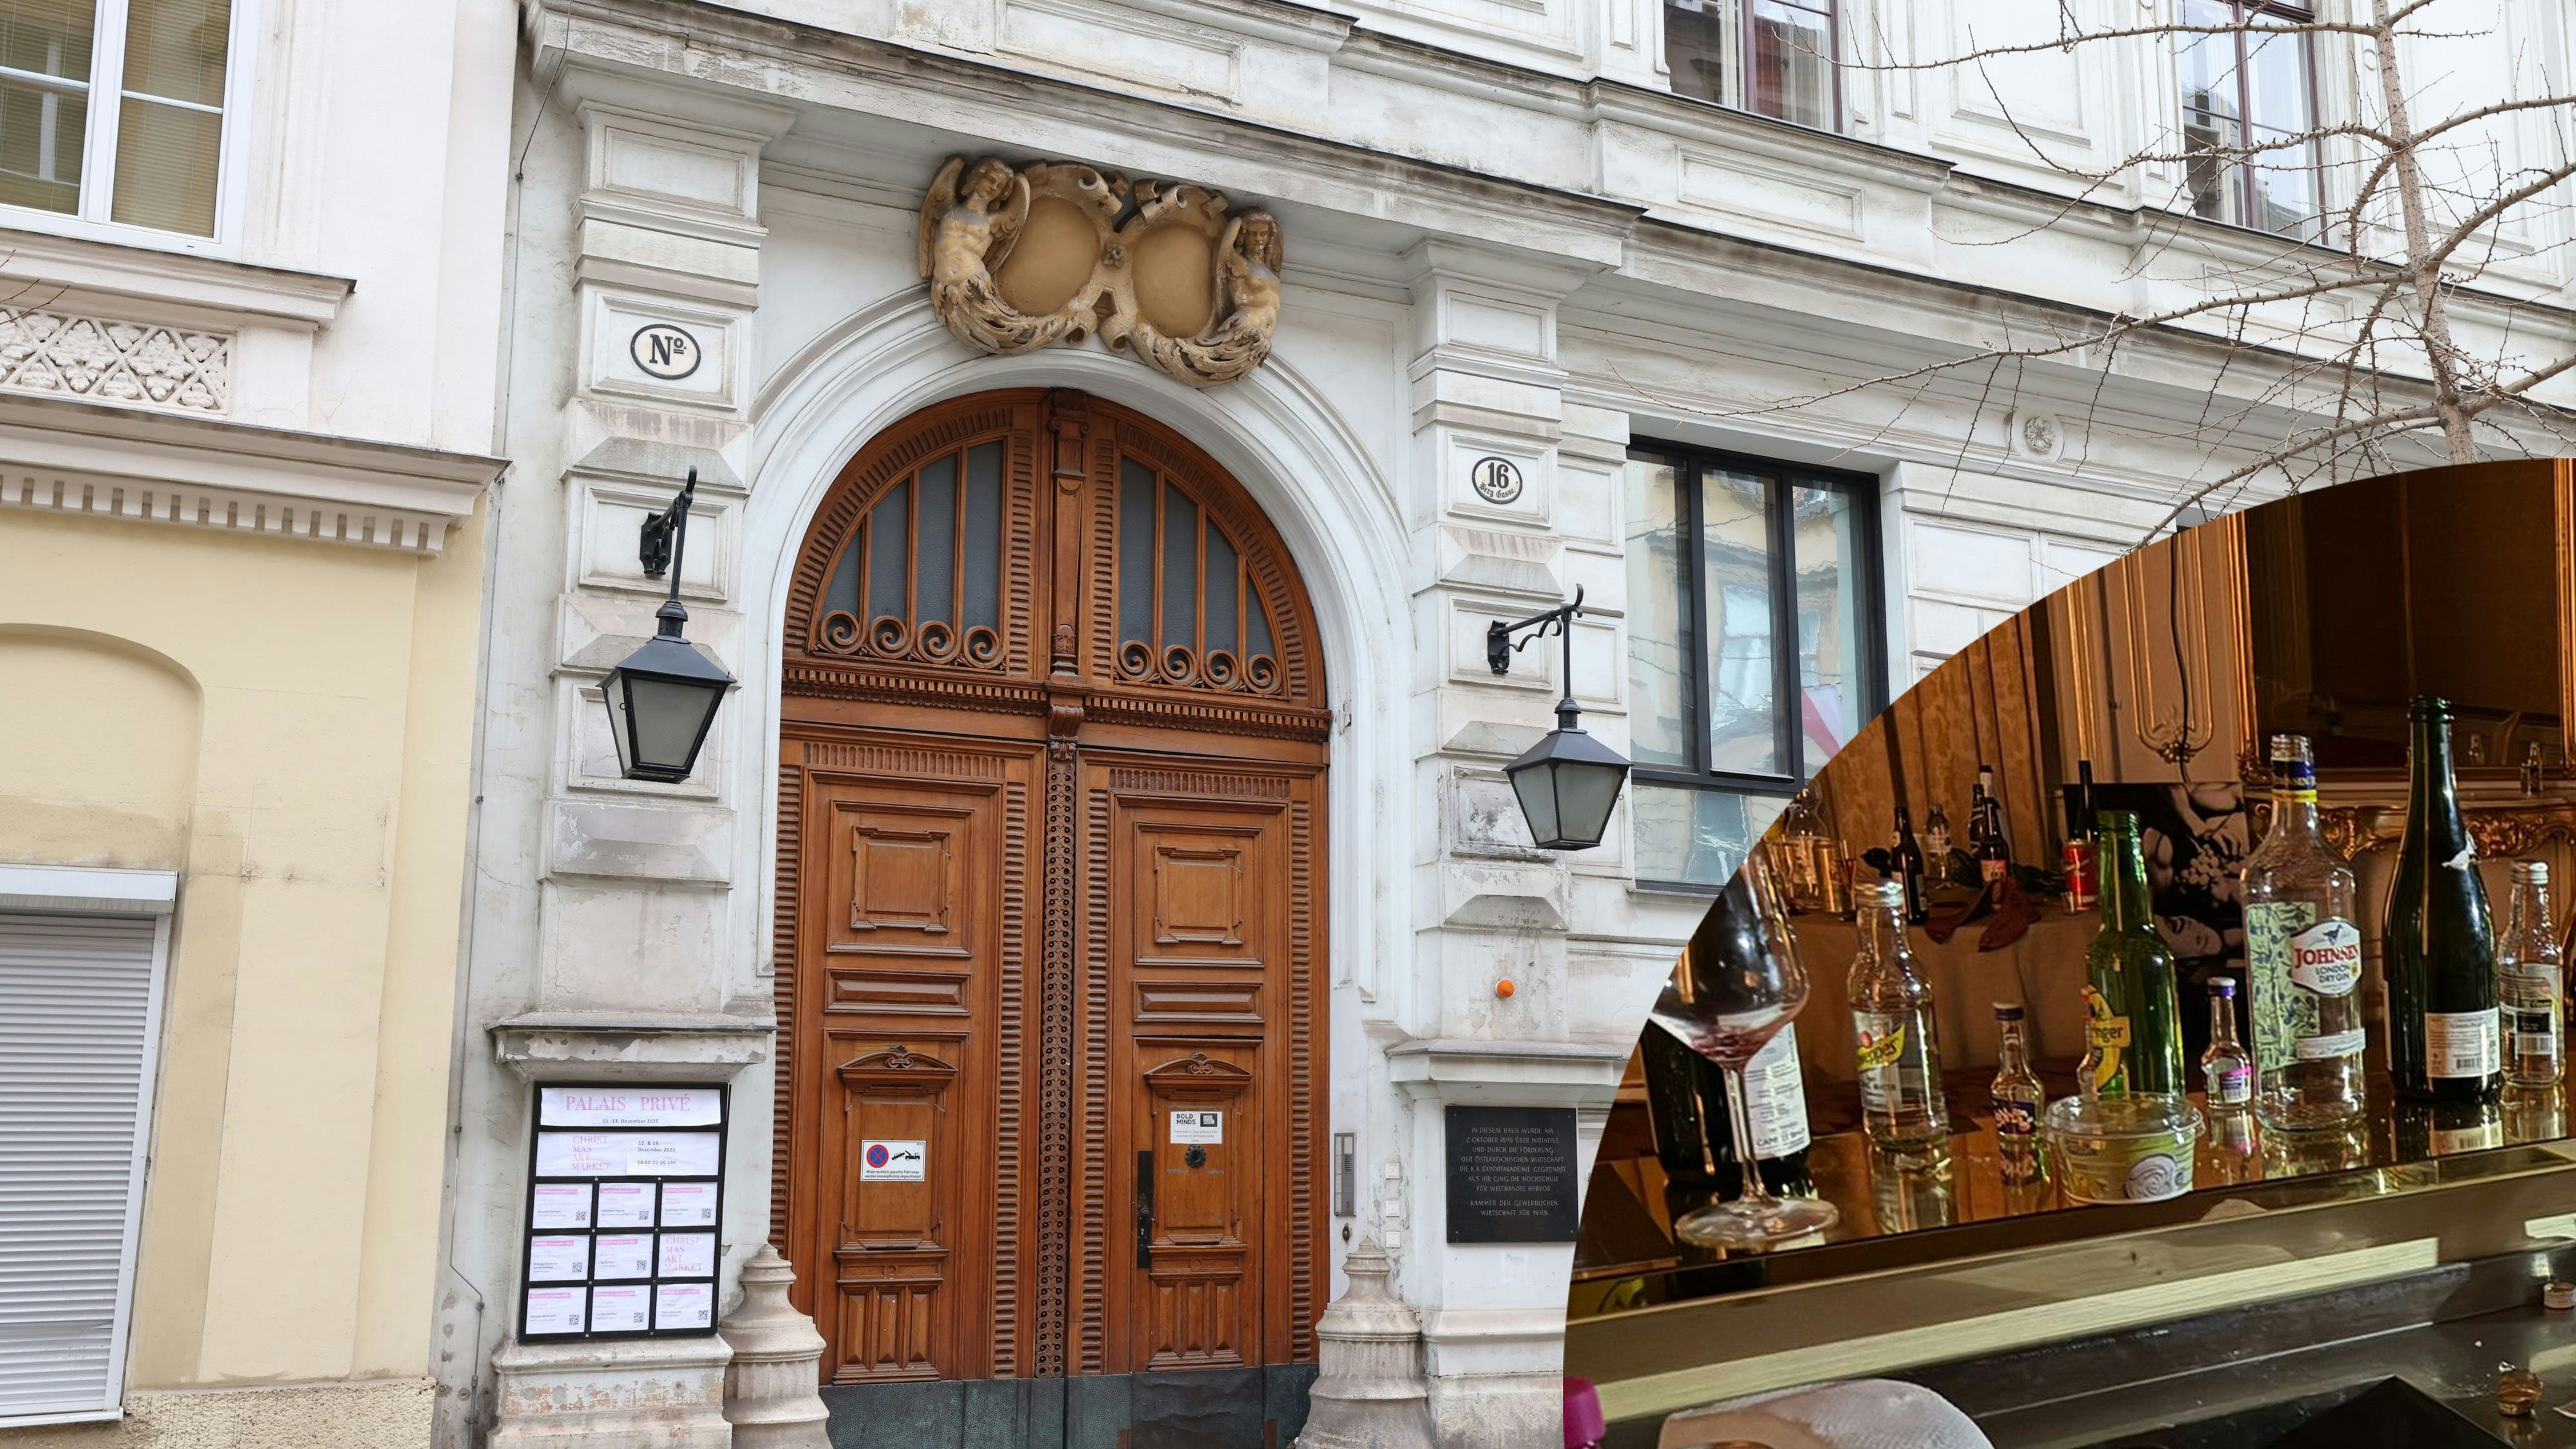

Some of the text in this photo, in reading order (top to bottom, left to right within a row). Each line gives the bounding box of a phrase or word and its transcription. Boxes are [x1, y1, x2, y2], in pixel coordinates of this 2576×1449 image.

[1488, 462, 1509, 489] 16
[1479, 482, 1494, 498] Berg
[2315, 964, 2350, 975] LONDON
[566, 1093, 690, 1112] PALAIS PRIVÉ
[573, 1135, 609, 1144] CHRIST
[573, 1144, 592, 1153] MAS
[572, 1162, 612, 1171] MARKET
[666, 1236, 701, 1244] CHRIST
[666, 1245, 685, 1254] MAS
[665, 1263, 703, 1271] MARKET
